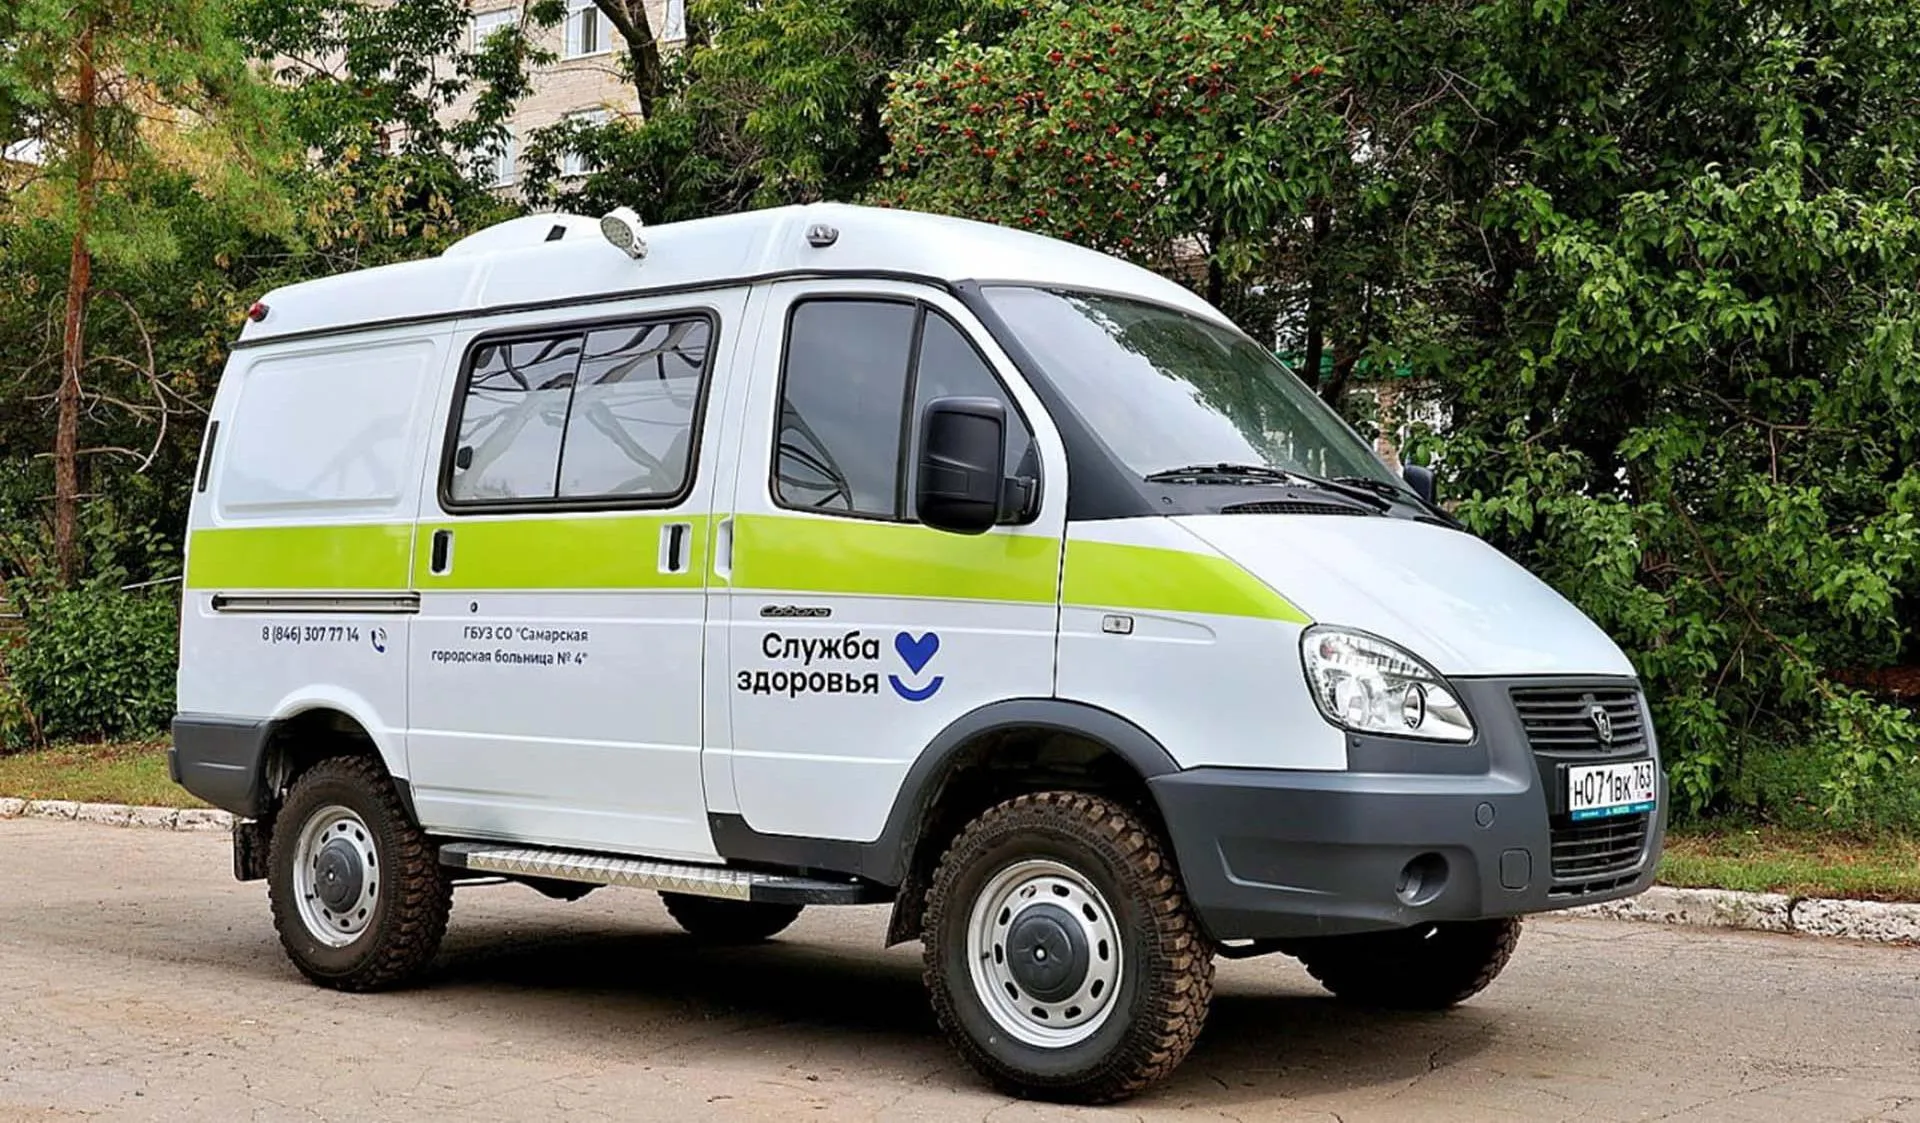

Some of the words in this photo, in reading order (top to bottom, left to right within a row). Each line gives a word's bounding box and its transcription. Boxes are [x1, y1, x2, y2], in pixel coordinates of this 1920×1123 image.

[262, 626, 270, 640] 8
[272, 626, 300, 644] (846)
[304, 626, 326, 641] 307
[328, 627, 343, 641] 77
[346, 627, 359, 642] 14
[463, 626, 493, 640] ГБУЗ
[495, 626, 513, 640] СО
[516, 627, 588, 644] "Самарская
[431, 650, 491, 664] городская
[495, 649, 554, 666] больница
[762, 630, 880, 666] Служба
[737, 670, 879, 698] здоровья
[1633, 764, 1651, 790] 763
